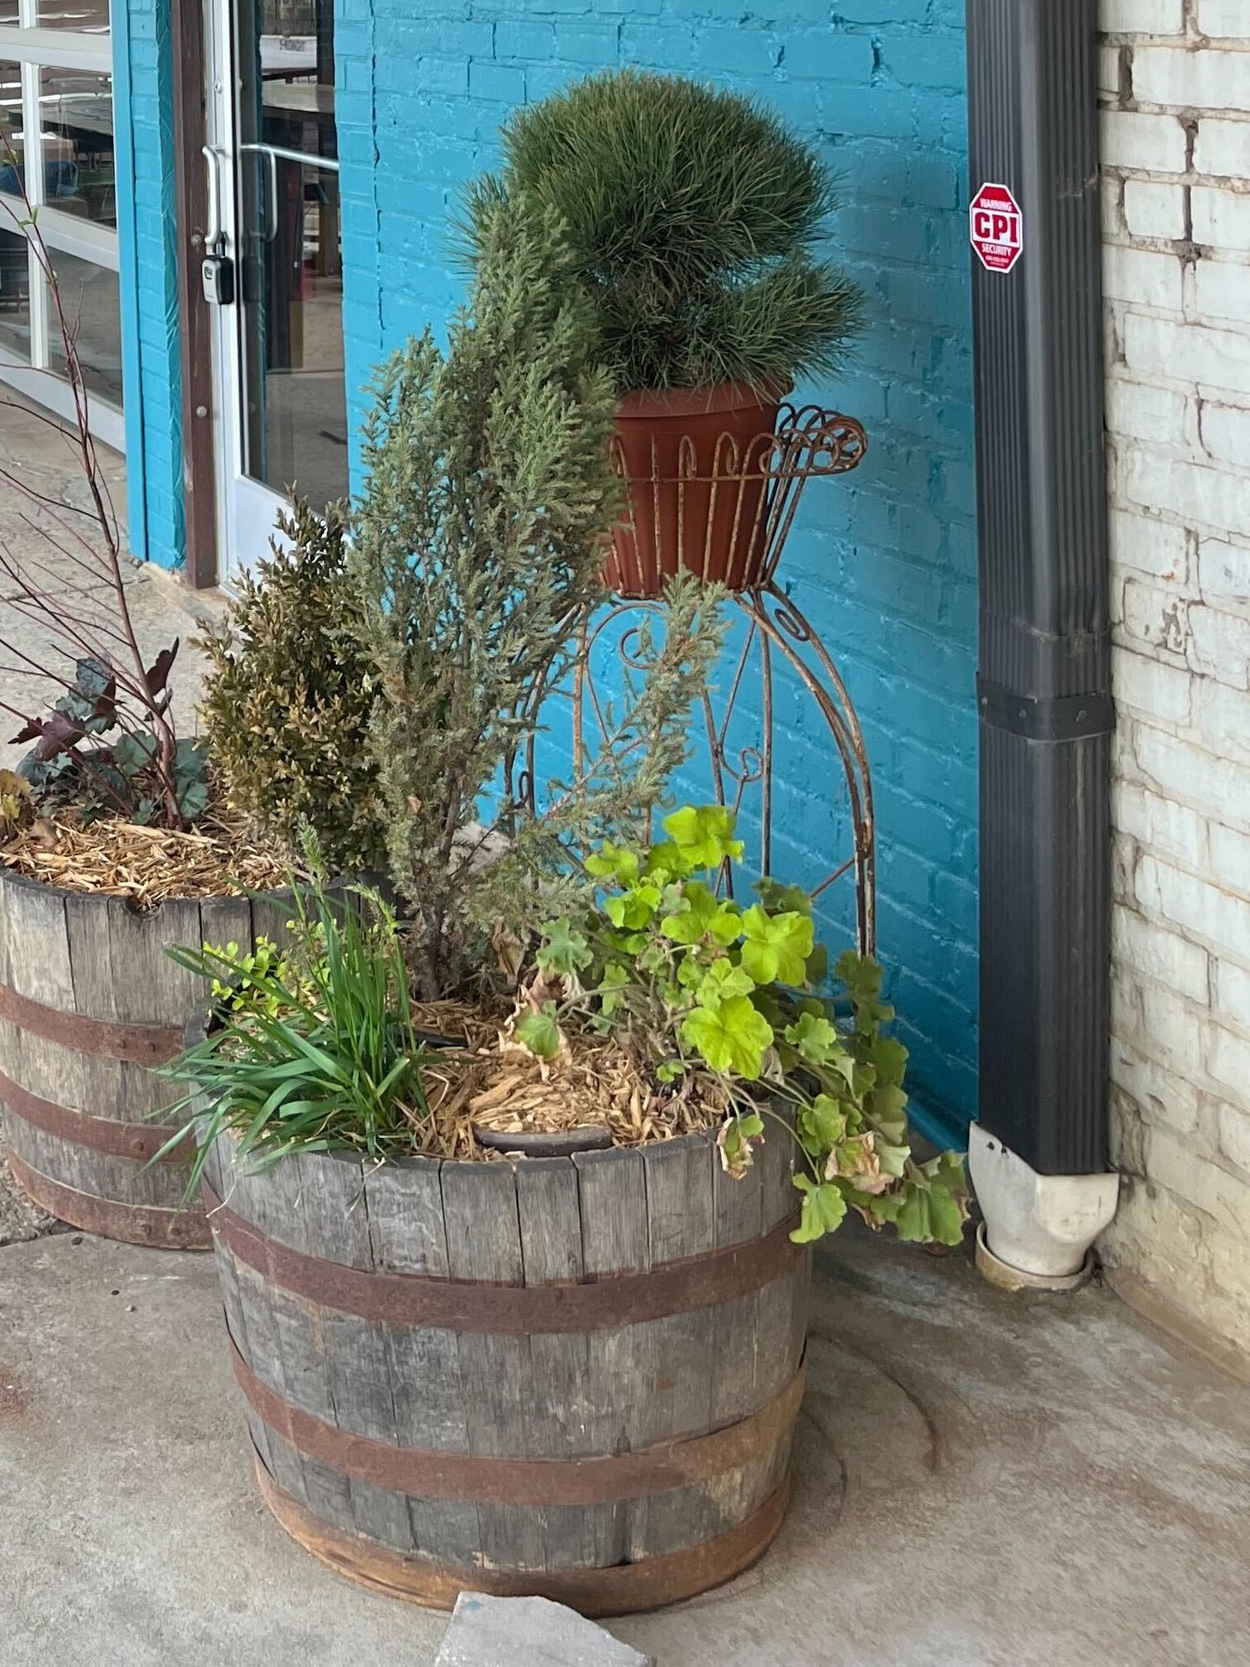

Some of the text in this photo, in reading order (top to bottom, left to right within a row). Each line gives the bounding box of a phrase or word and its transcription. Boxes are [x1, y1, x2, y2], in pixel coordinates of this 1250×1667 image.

[980, 198, 1012, 211] WARNING
[974, 212, 1018, 244] CPI
[982, 243, 1011, 256] SECURITY
